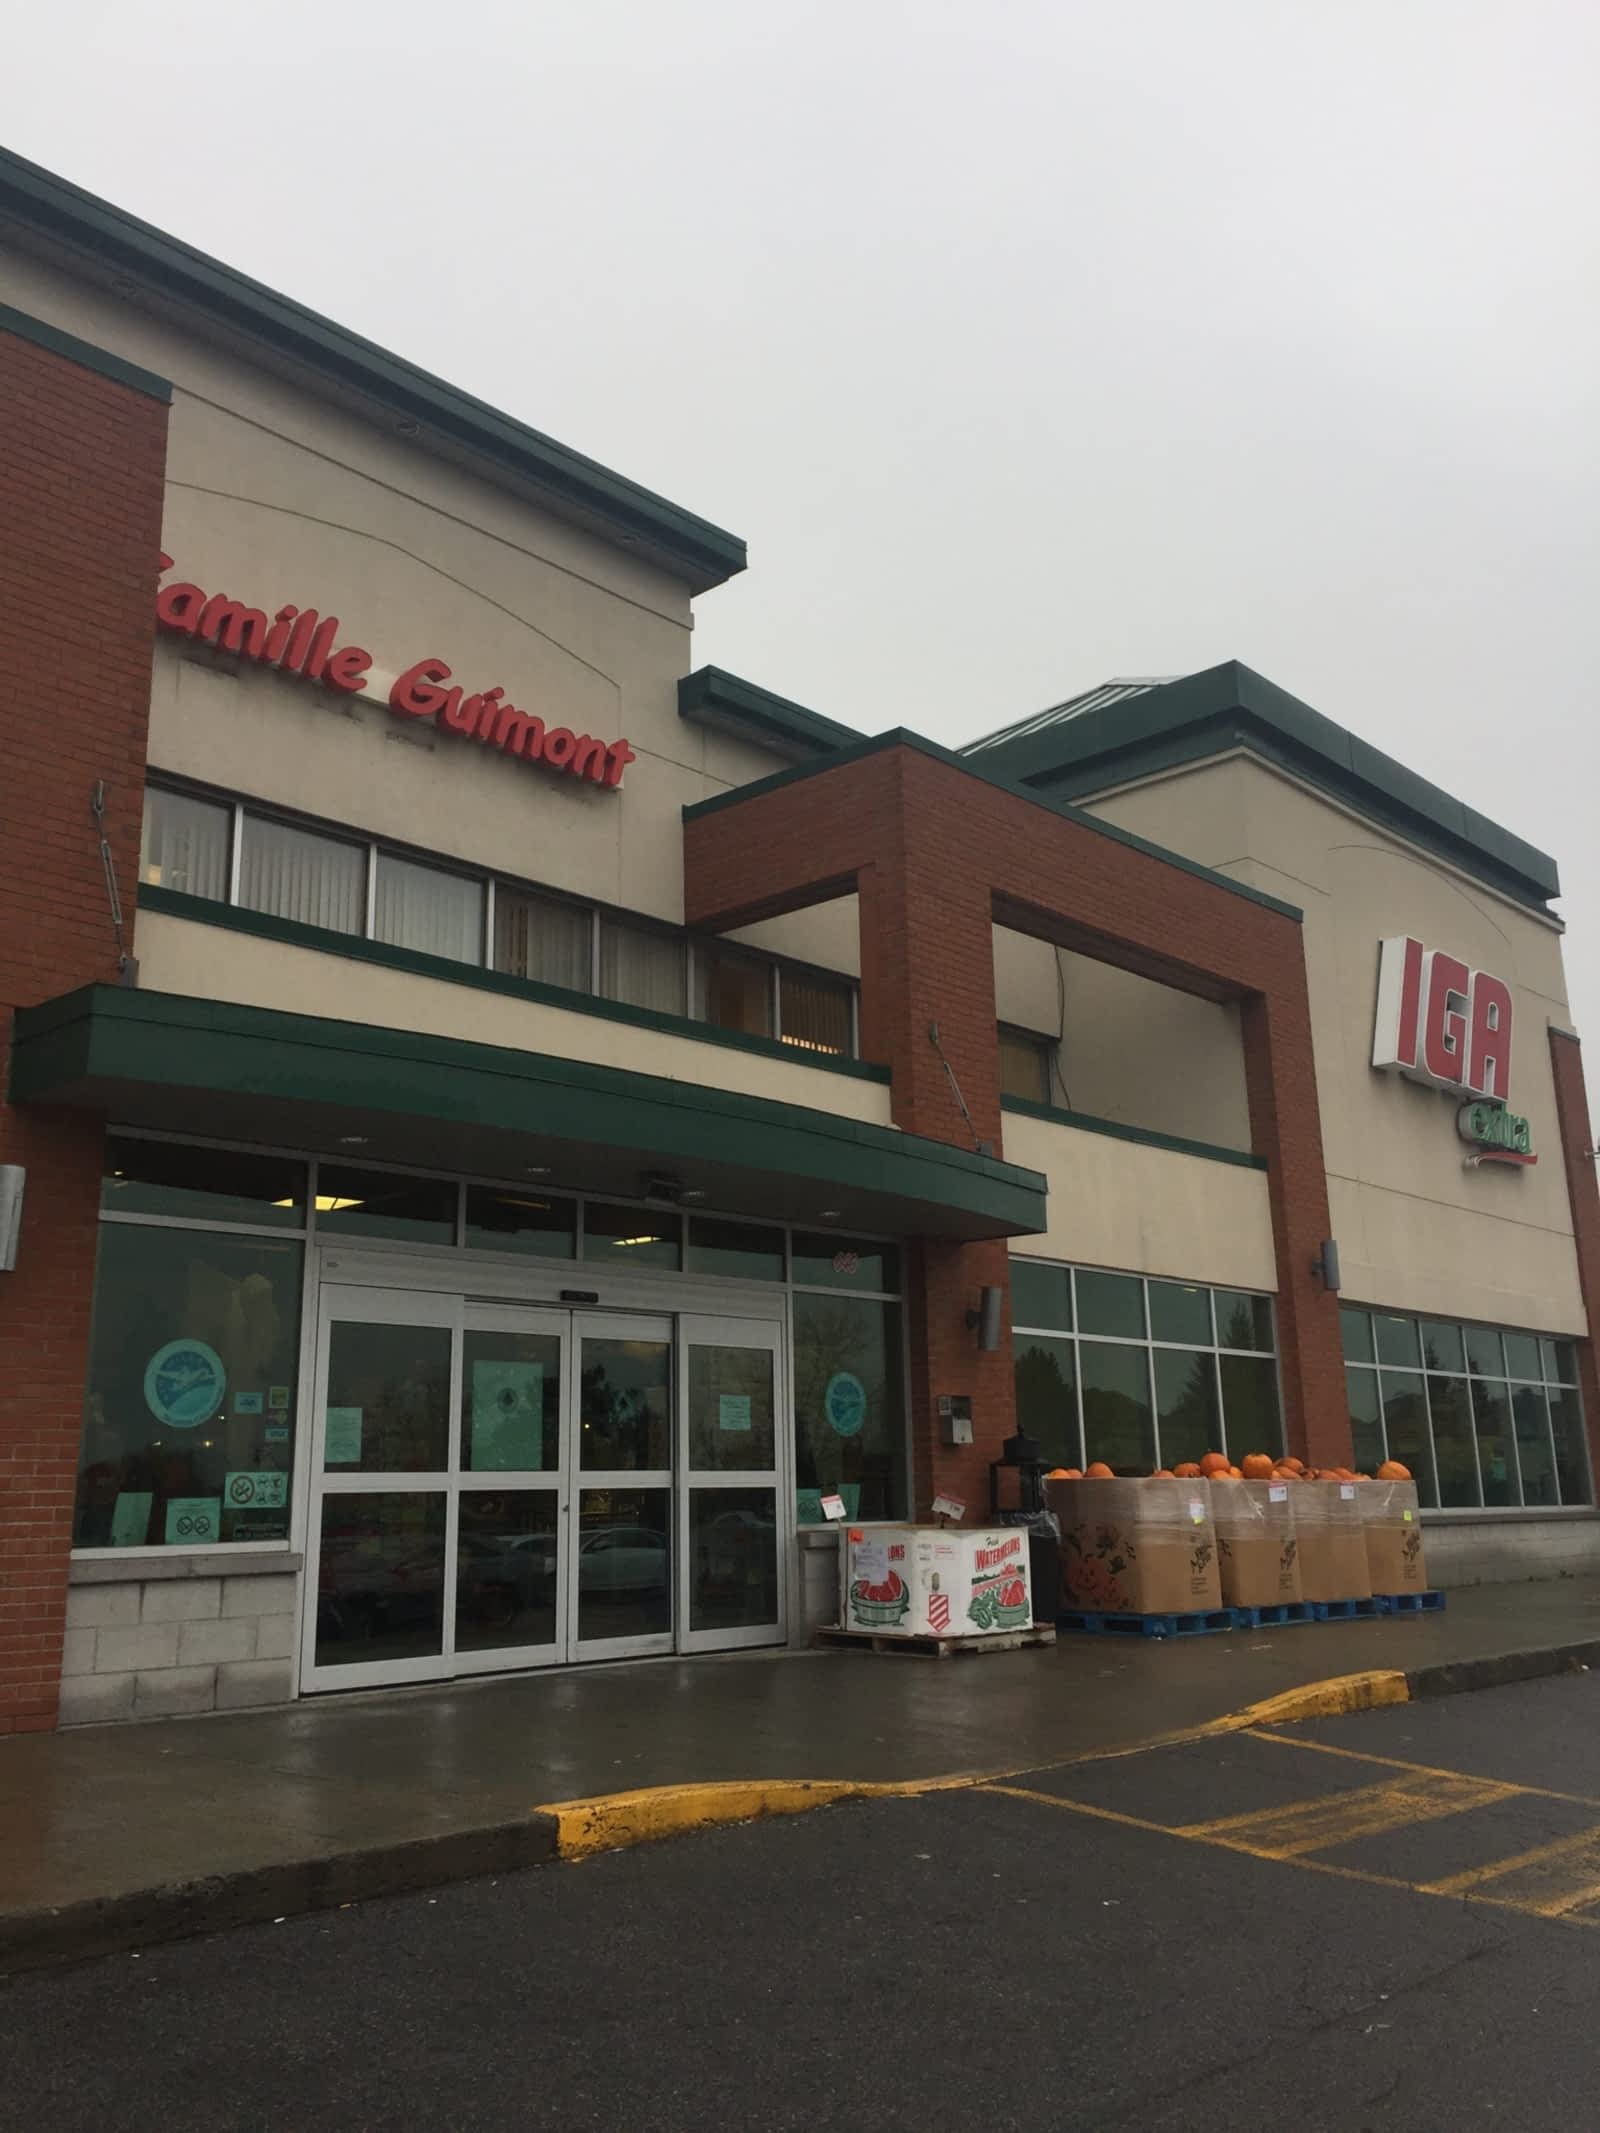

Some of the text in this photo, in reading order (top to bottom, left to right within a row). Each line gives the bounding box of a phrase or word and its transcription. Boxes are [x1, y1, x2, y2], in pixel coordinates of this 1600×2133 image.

[156, 552, 635, 788] amille Guimont
[1388, 934, 1513, 1103] IGA
[1463, 1102, 1532, 1154] extra
